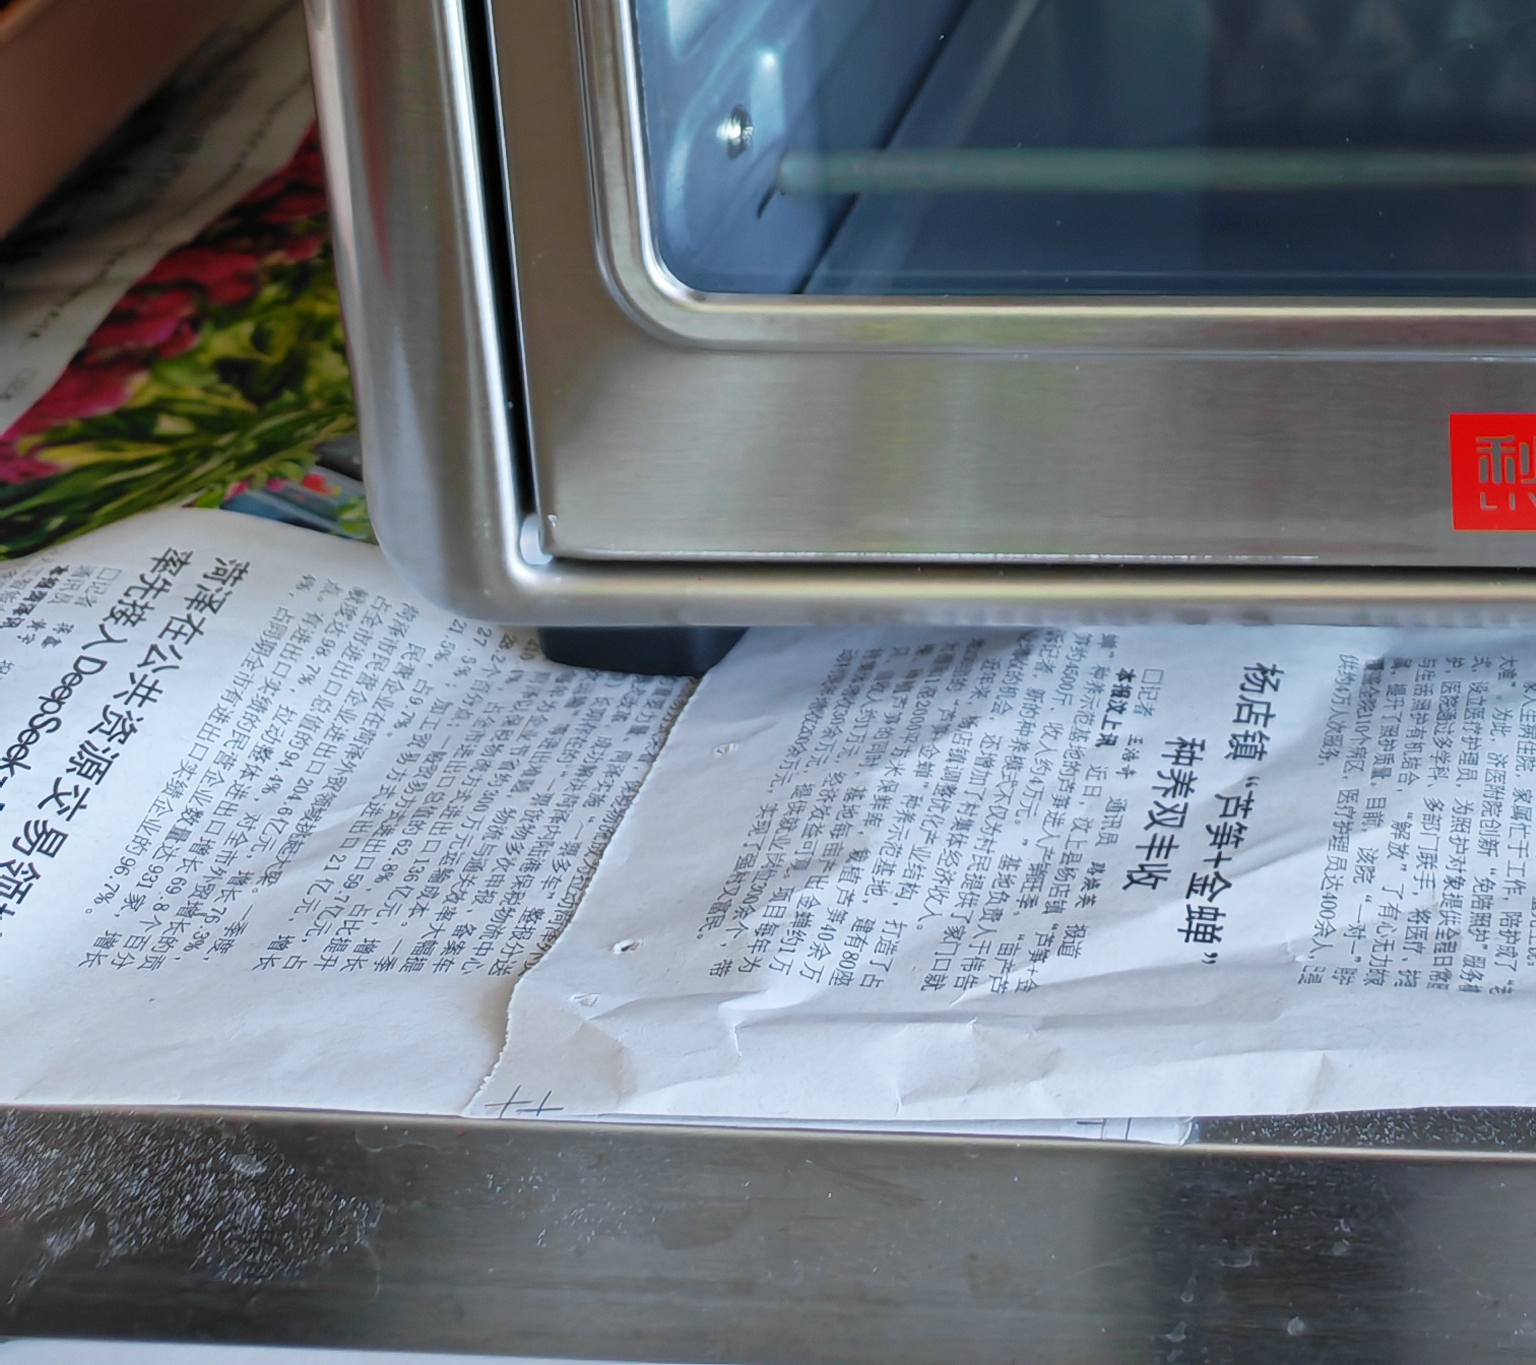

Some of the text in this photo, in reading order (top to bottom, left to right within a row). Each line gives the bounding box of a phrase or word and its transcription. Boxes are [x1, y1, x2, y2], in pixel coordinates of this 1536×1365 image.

[1092, 667, 1138, 747] 本报汶上讯
[1130, 686, 1160, 717] 记者
[0, 556, 251, 941] 菏泽在公共资源交易领
[1093, 798, 1129, 846] 通讯员
[1121, 736, 1207, 891] 种养双丰收
[1167, 663, 1286, 965] 杨店镇“芦笋+金蝉”
[1054, 923, 1090, 959] 报道
